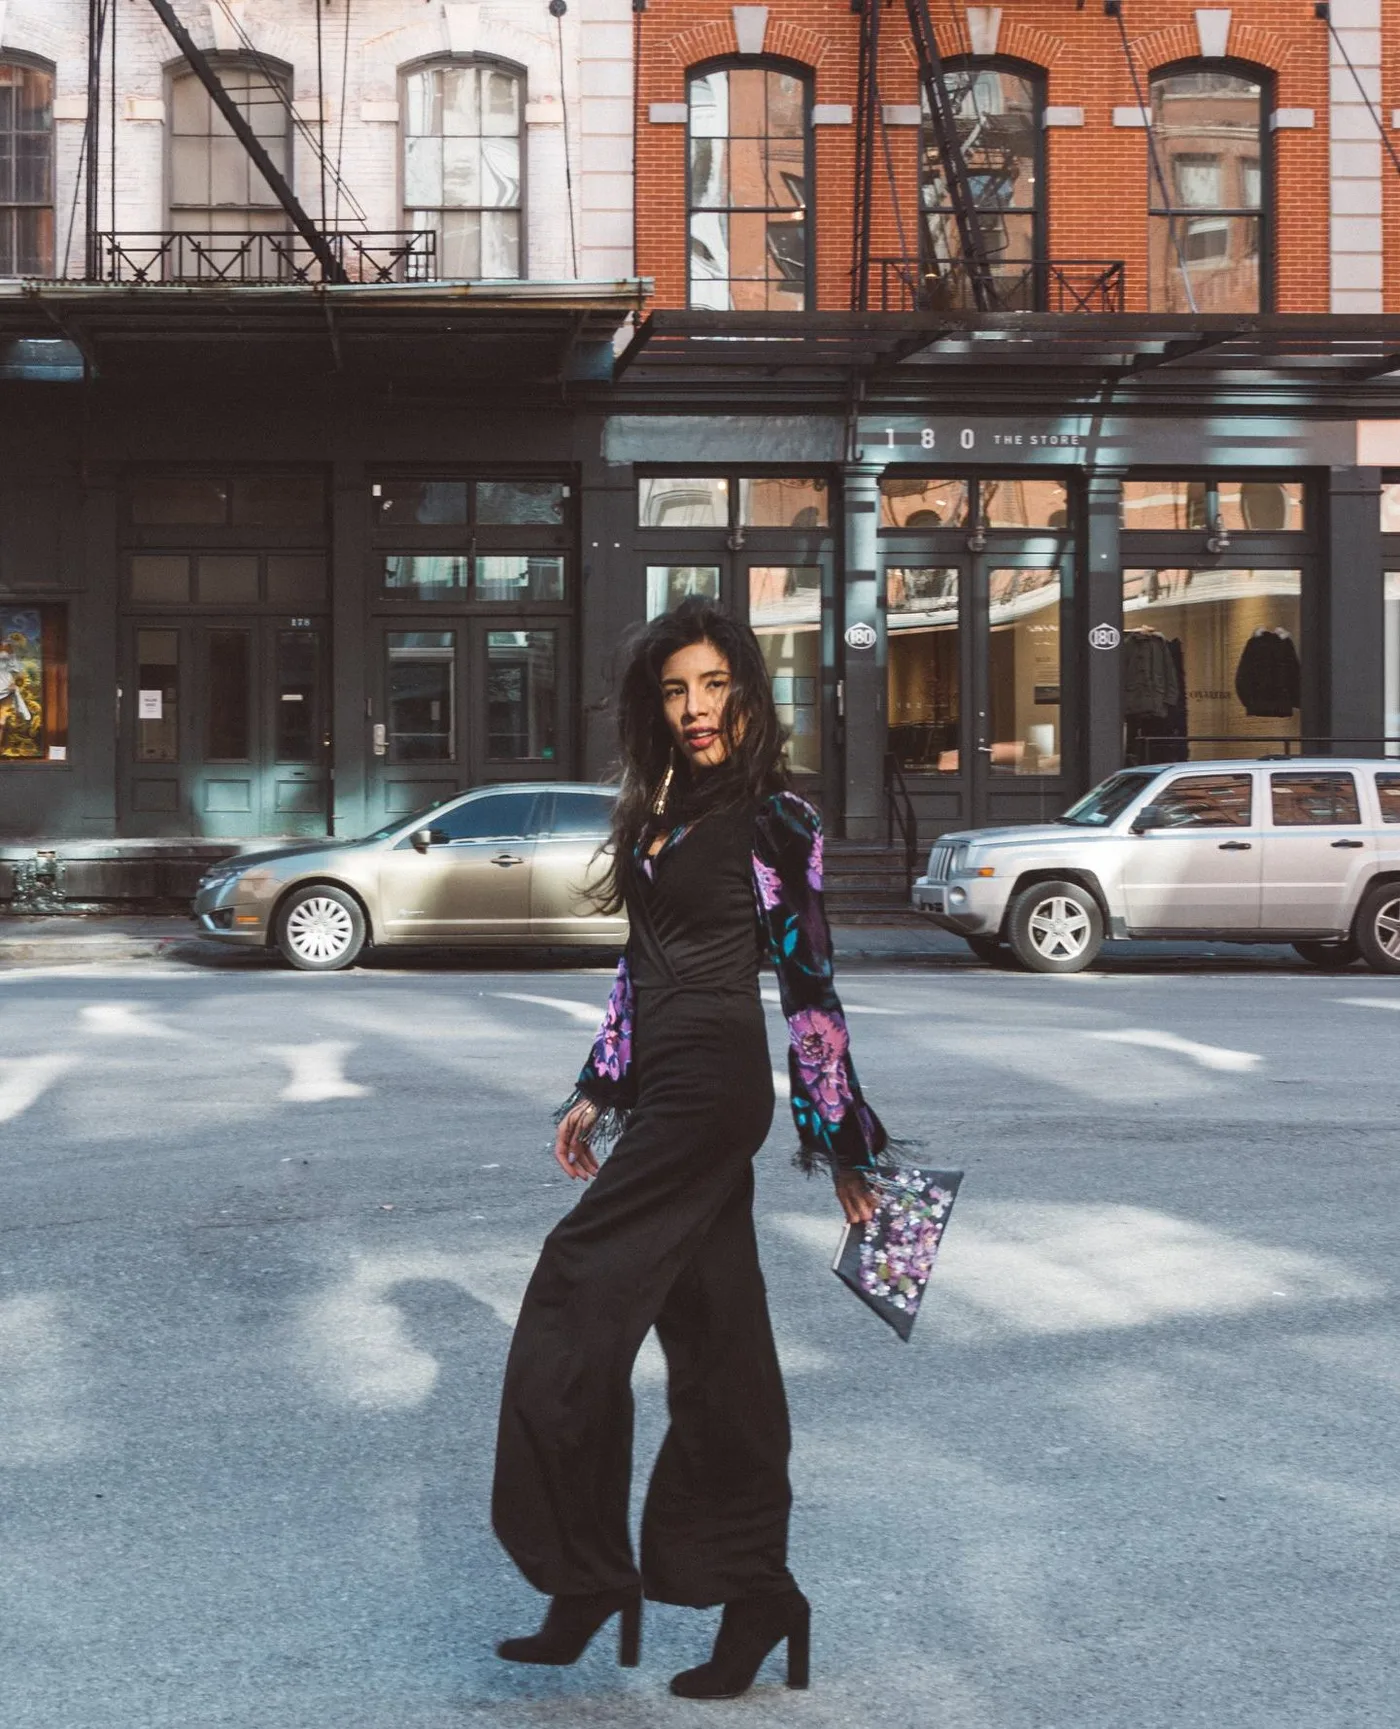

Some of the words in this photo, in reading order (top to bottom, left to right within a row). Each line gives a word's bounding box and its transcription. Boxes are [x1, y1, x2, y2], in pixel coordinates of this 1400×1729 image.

[994, 435, 1023, 445] THE
[1030, 435, 1079, 445] STORE
[849, 629, 872, 645] 180
[1094, 630, 1116, 645] 180
